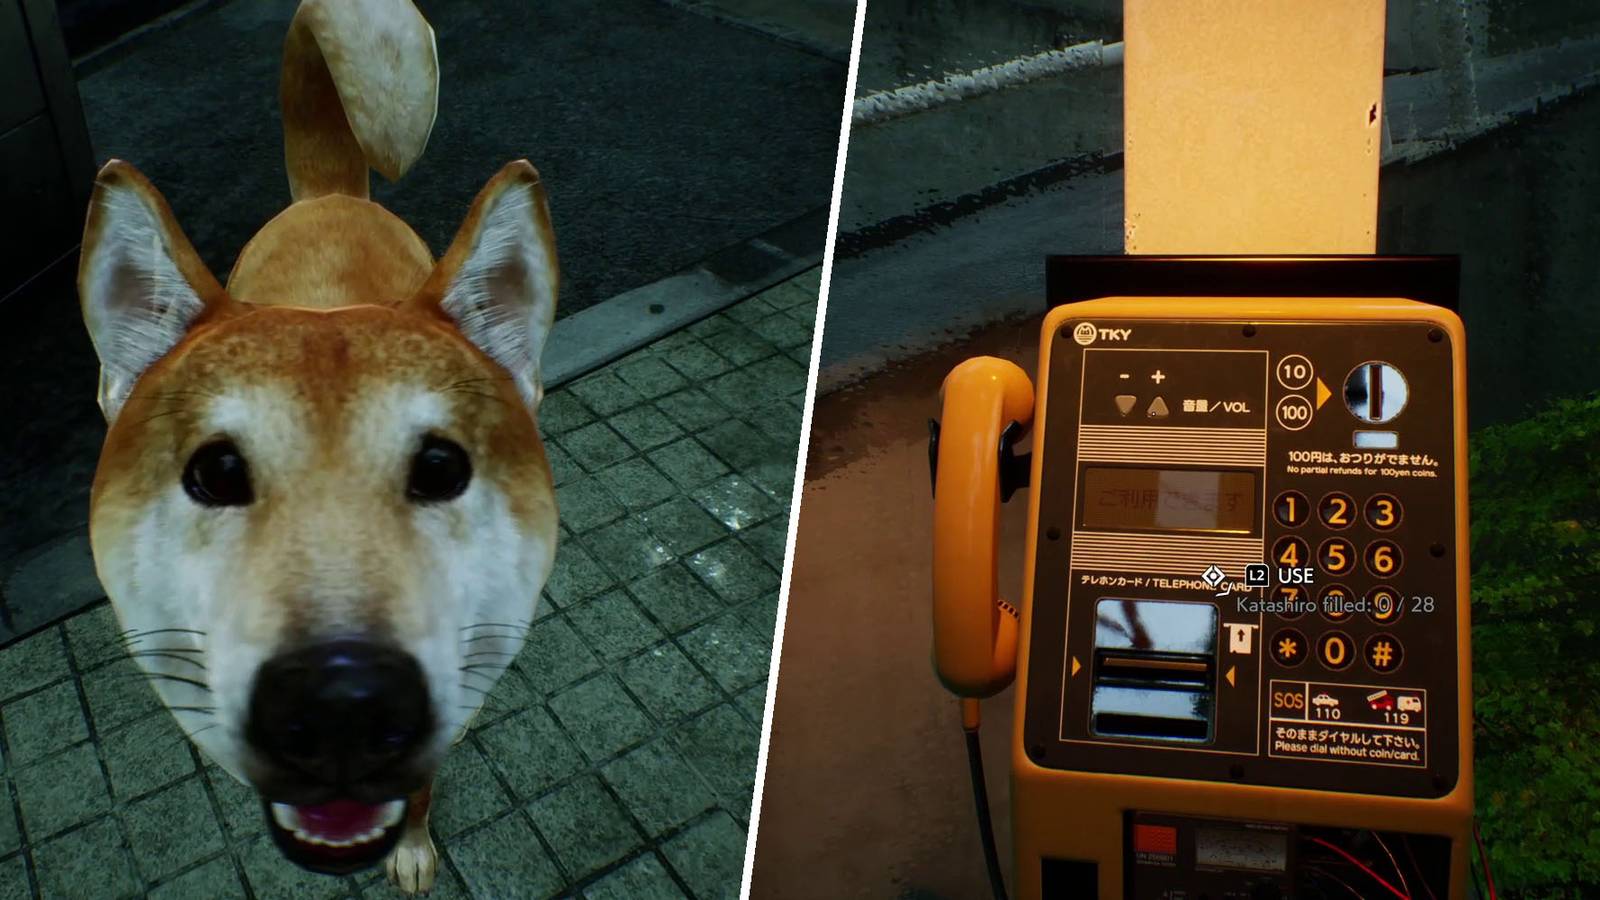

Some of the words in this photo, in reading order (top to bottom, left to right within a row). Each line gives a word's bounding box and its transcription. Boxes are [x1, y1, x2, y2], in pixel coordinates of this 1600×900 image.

[1098, 328, 1132, 342] TKY
[1283, 364, 1307, 380] 10
[1282, 405, 1308, 420] 100
[1287, 465, 1300, 474] No
[1300, 467, 1329, 475] partial
[1329, 467, 1363, 476] refunds
[1364, 467, 1377, 476] for
[1285, 496, 1296, 522] 1
[1328, 498, 1348, 524] 2
[1375, 499, 1395, 526] 3
[1279, 542, 1299, 568] 4
[1327, 544, 1346, 571] 5
[1374, 546, 1394, 573] 6
[1081, 575, 1143, 587] テレホンカード
[1324, 637, 1345, 665] 0
[1274, 692, 1304, 710] SOS
[1316, 707, 1341, 720] 110
[1384, 712, 1409, 725] 119
[1275, 740, 1308, 753] Please
[1309, 743, 1328, 754] dial
[1329, 745, 1367, 758] without
[1369, 748, 1420, 761] coin/card.
